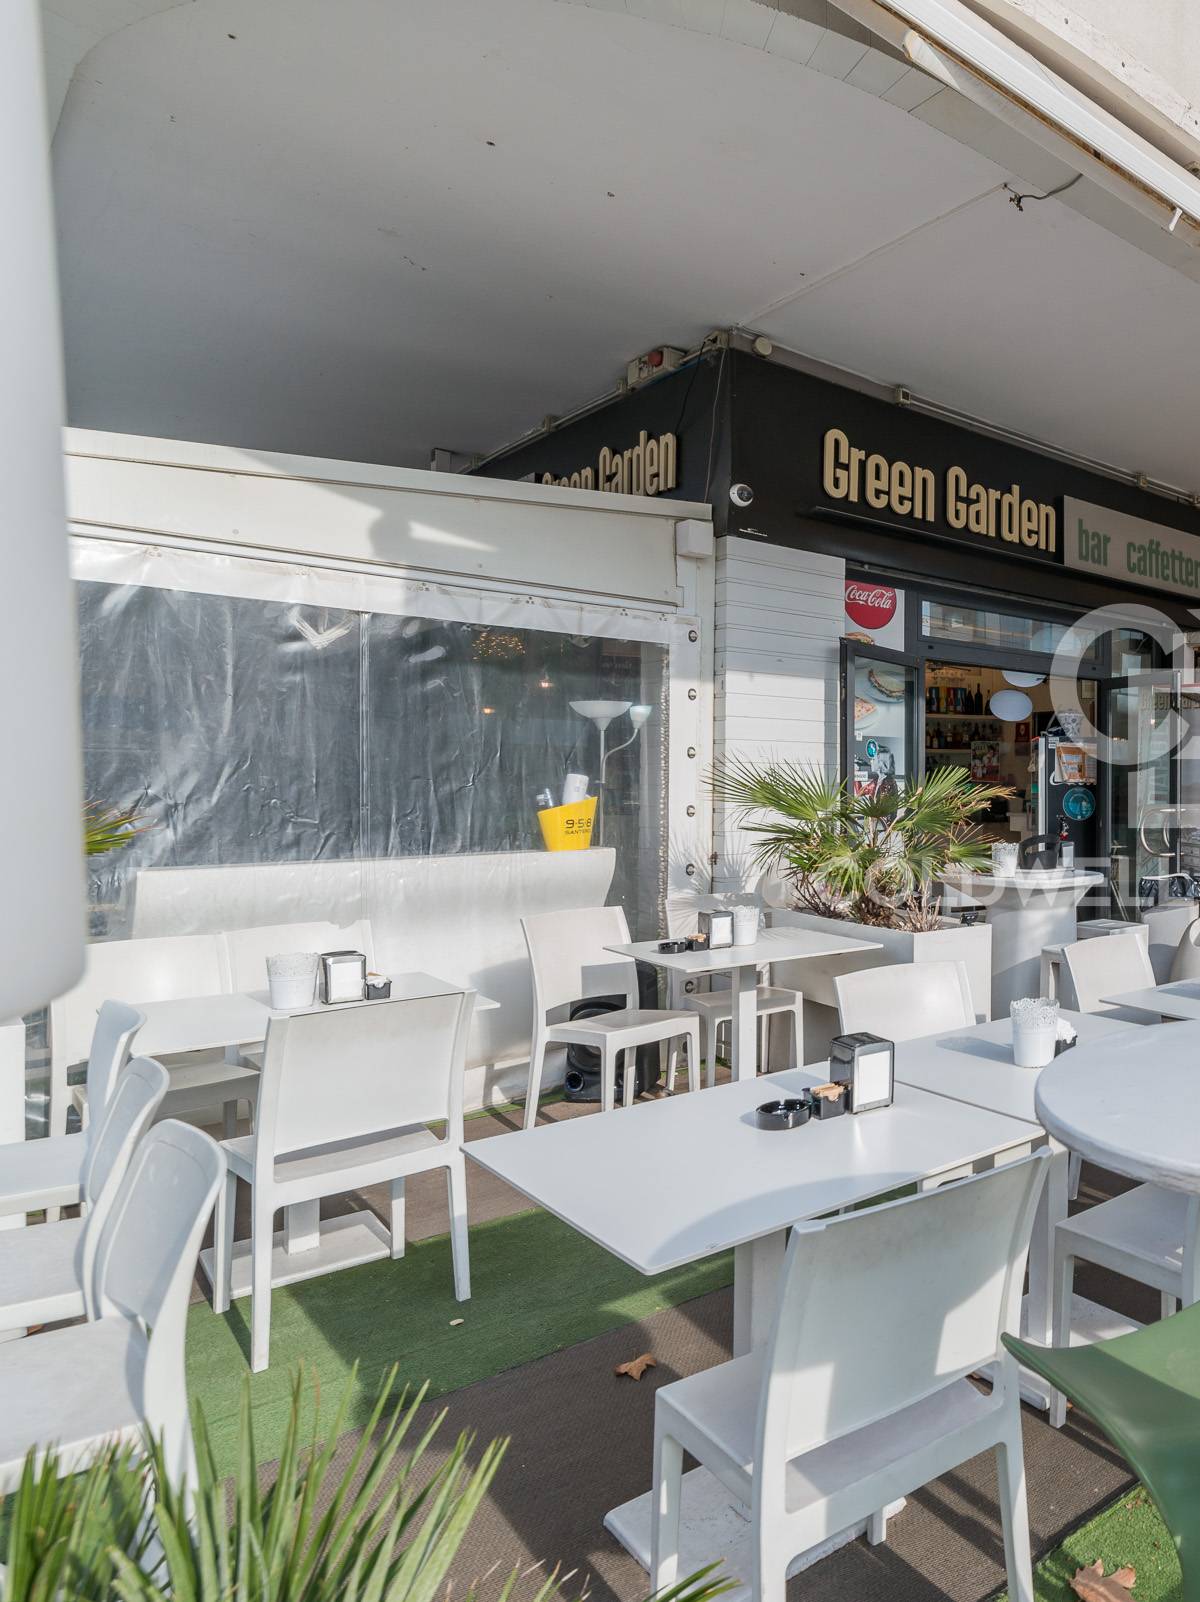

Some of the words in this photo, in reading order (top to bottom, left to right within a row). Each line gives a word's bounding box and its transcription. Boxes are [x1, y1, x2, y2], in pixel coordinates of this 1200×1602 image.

[598, 430, 676, 495] Garden
[823, 428, 935, 522] Green
[947, 465, 1056, 552] Garden
[1077, 519, 1111, 566] bar
[845, 584, 893, 609] Coca-Cola
